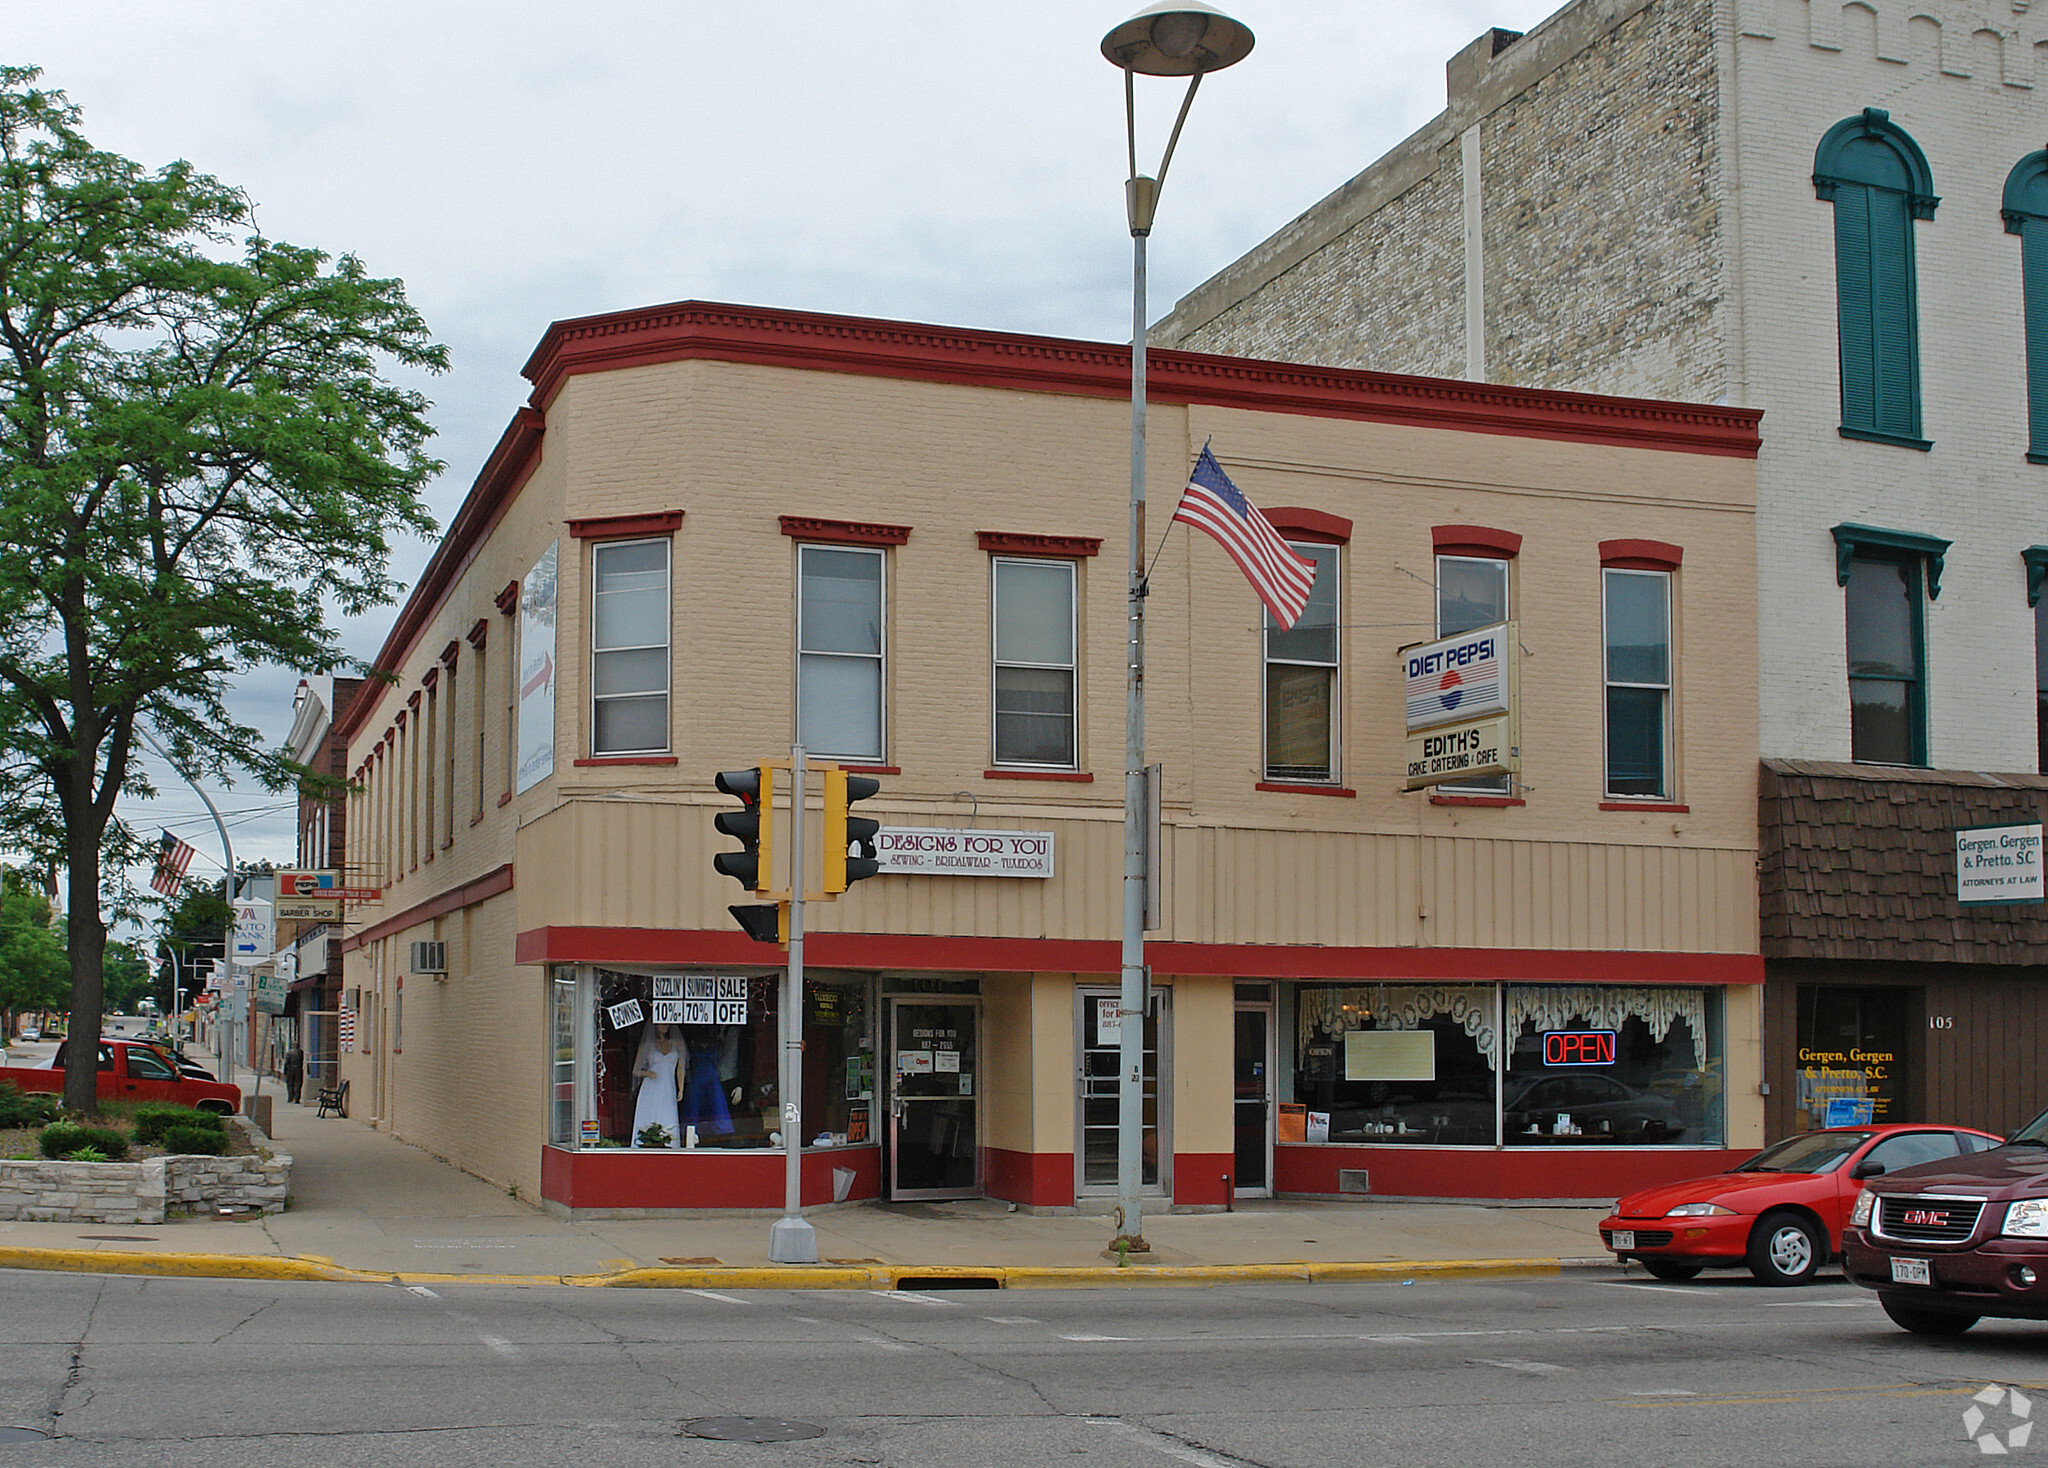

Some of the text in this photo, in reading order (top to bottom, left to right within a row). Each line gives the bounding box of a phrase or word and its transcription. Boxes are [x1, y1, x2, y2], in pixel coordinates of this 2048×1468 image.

[1409, 638, 1495, 678] DIET PEPSI
[1423, 729, 1480, 758] EDITH'S
[1408, 760, 1428, 776] CAKE
[1431, 752, 1469, 773] CATERING
[1476, 748, 1498, 765] CAFE
[880, 834, 1047, 855] DESIGNS FOR YOU
[2000, 834, 2040, 850] Gergen
[890, 854, 925, 866] SEWING
[935, 855, 991, 868] BRIDALWEAR
[1001, 857, 1043, 870] TUXEDOS
[1963, 856, 1973, 868] &
[1962, 875, 2038, 887] ATTORNEYS AT LAW
[280, 909, 333, 917] BARBER SHOP
[687, 978, 714, 997] SUMMER
[719, 978, 746, 998] SALE
[612, 1001, 642, 1027] GOWNS
[686, 1002, 708, 1022] 70%
[718, 1003, 745, 1022] OFF
[1930, 1016, 1953, 1030] 105
[913, 1028, 957, 1038] DESIGNS FOR YOU
[1308, 1047, 1332, 1056] OPEN
[1546, 1034, 1613, 1062] OPEN
[1799, 1047, 1894, 1065] Gergen, Gergen
[916, 1058, 929, 1066] Open
[1804, 1065, 1888, 1081] & Pretto, S.C.
[1814, 1085, 1854, 1093] ATTORNEYS
[1865, 1085, 1879, 1093] LAW
[1903, 1210, 1950, 1226] GMC
